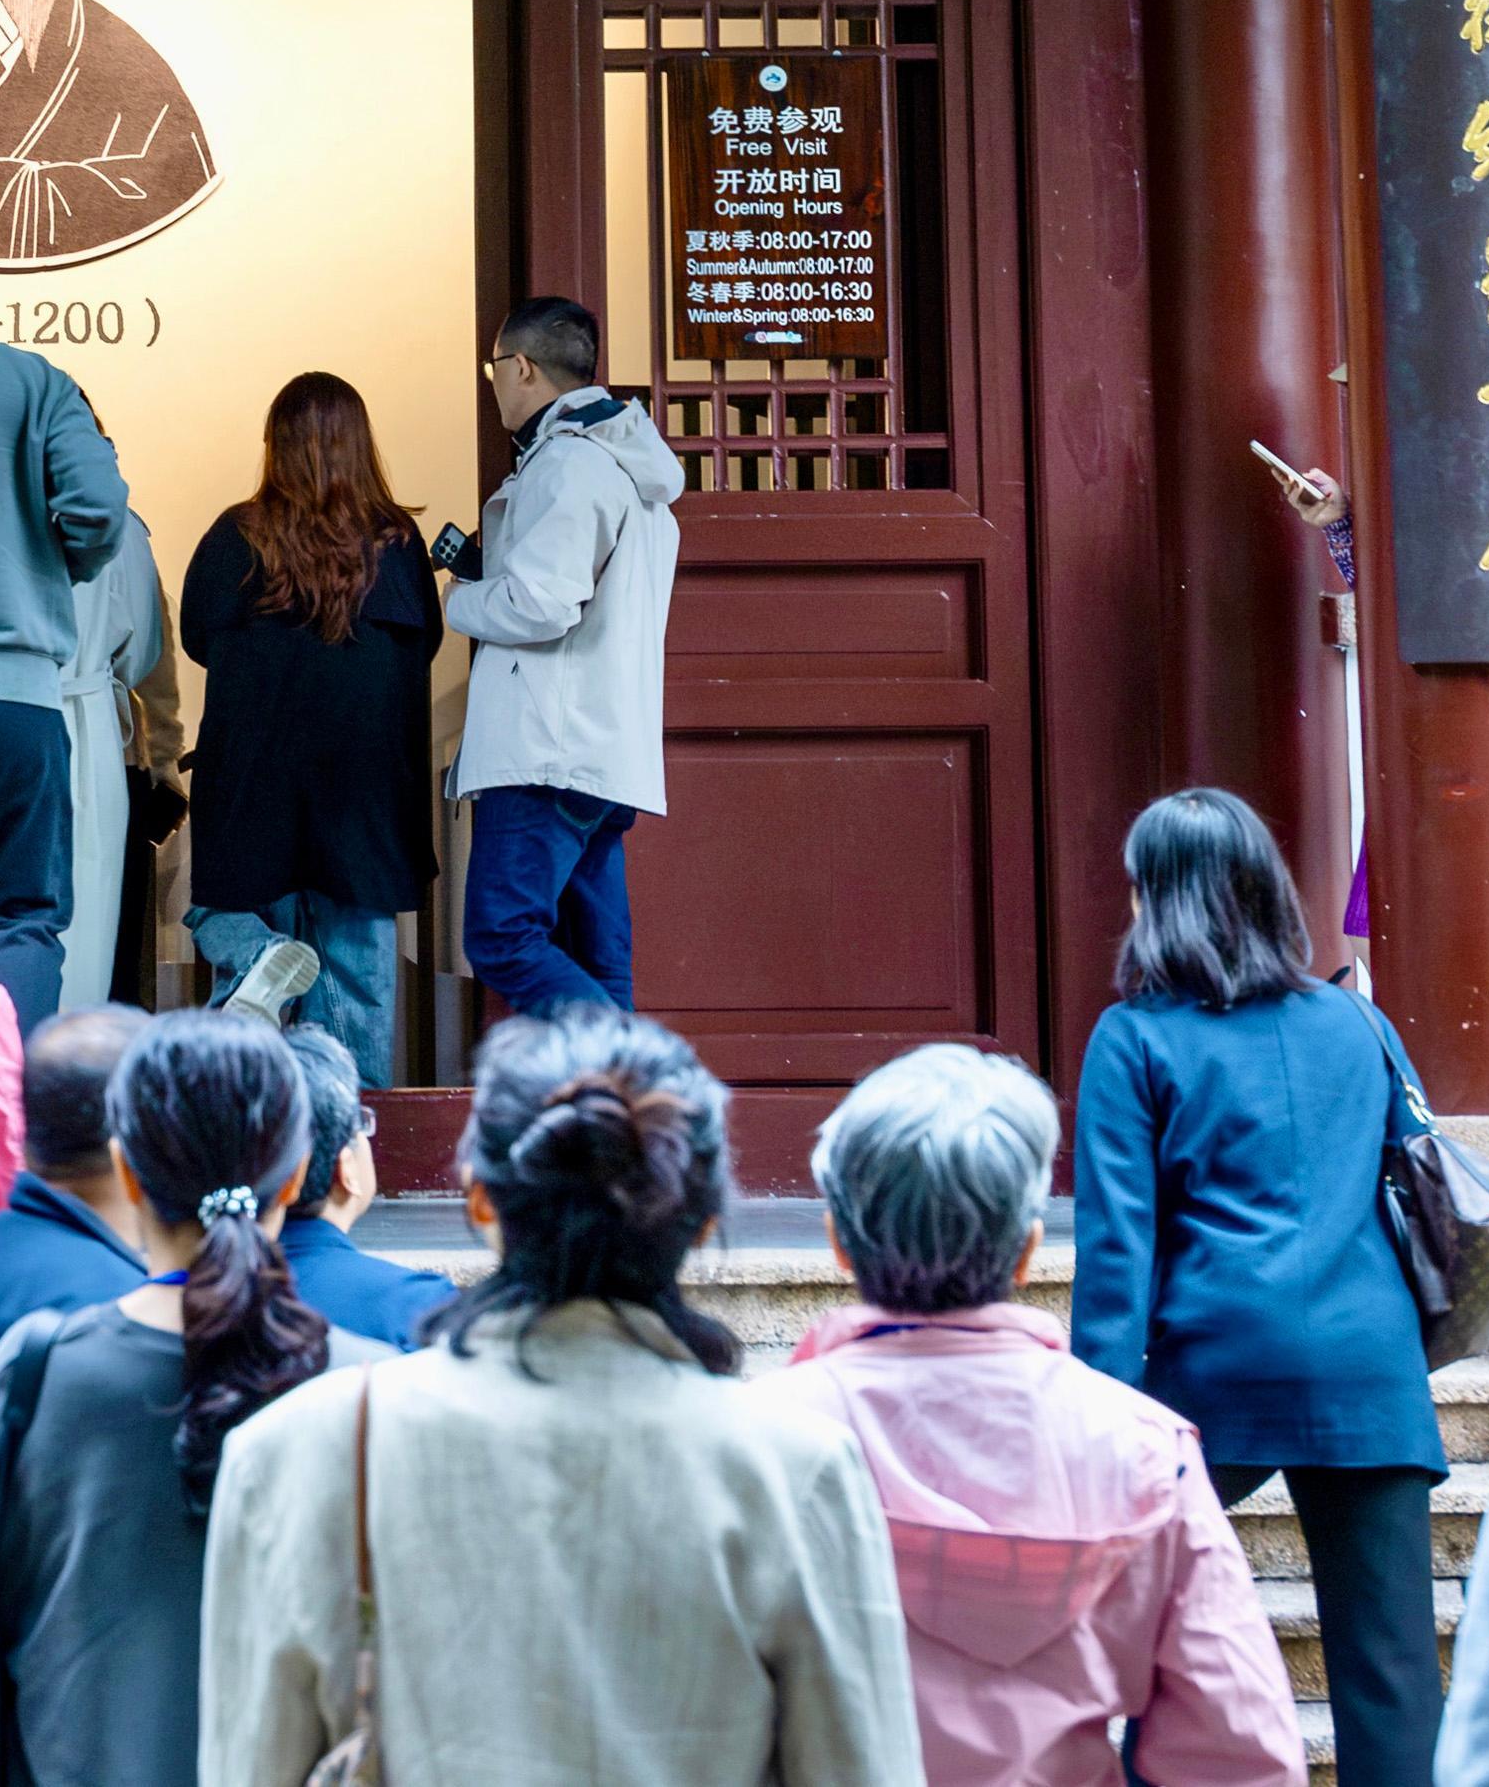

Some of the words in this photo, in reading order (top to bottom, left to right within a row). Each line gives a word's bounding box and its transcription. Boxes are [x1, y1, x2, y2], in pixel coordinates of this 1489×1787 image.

[708, 107, 844, 135] 免费参观
[725, 138, 772, 156] Free
[783, 137, 828, 156] Visit
[714, 168, 842, 194] 开放时间
[714, 199, 784, 219] Opening
[793, 198, 843, 215] Hours
[686, 257, 873, 276] Summer&Autumn:08:00-17:00
[687, 308, 875, 325] Winter&Spring:08:00-16:30
